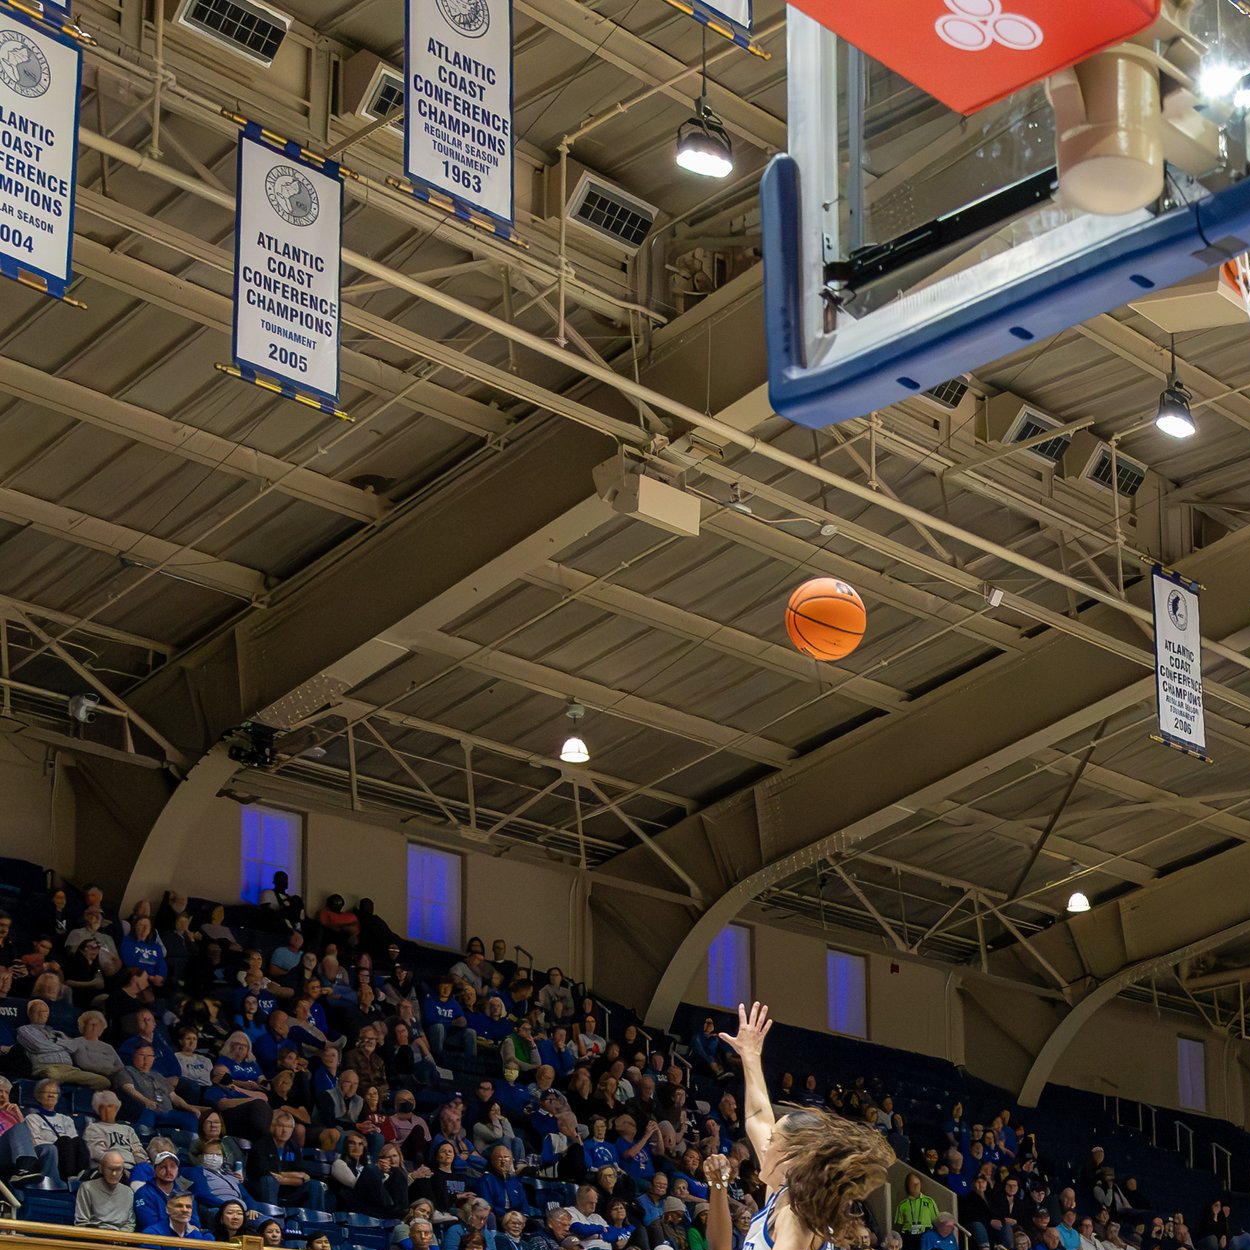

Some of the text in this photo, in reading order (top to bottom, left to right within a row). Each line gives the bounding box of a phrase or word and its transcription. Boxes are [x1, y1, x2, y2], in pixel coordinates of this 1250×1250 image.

[427, 36, 496, 85] ATLANTIC
[438, 65, 486, 102] COAST
[413, 73, 509, 137] CONFERENCE
[418, 98, 506, 156] CHAMPIONS
[424, 122, 499, 167] REGULAR SEASON
[432, 139, 491, 176] TOURNAMENT
[441, 160, 482, 193] 1963
[17, 210, 54, 235] SEASON
[257, 231, 324, 273] ATLANTIC
[267, 257, 314, 289] COAST
[243, 265, 337, 319] CONFERENCE
[246, 289, 333, 337] CHAMPIONS
[261, 319, 317, 350] TOURNAMENT
[268, 343, 308, 373] 2005
[1164, 639, 1194, 663] ATLANTIC
[1169, 655, 1191, 675] COAST
[1159, 664, 1202, 694] CONFERENCE
[1162, 680, 1201, 708] CHAMPIONS
